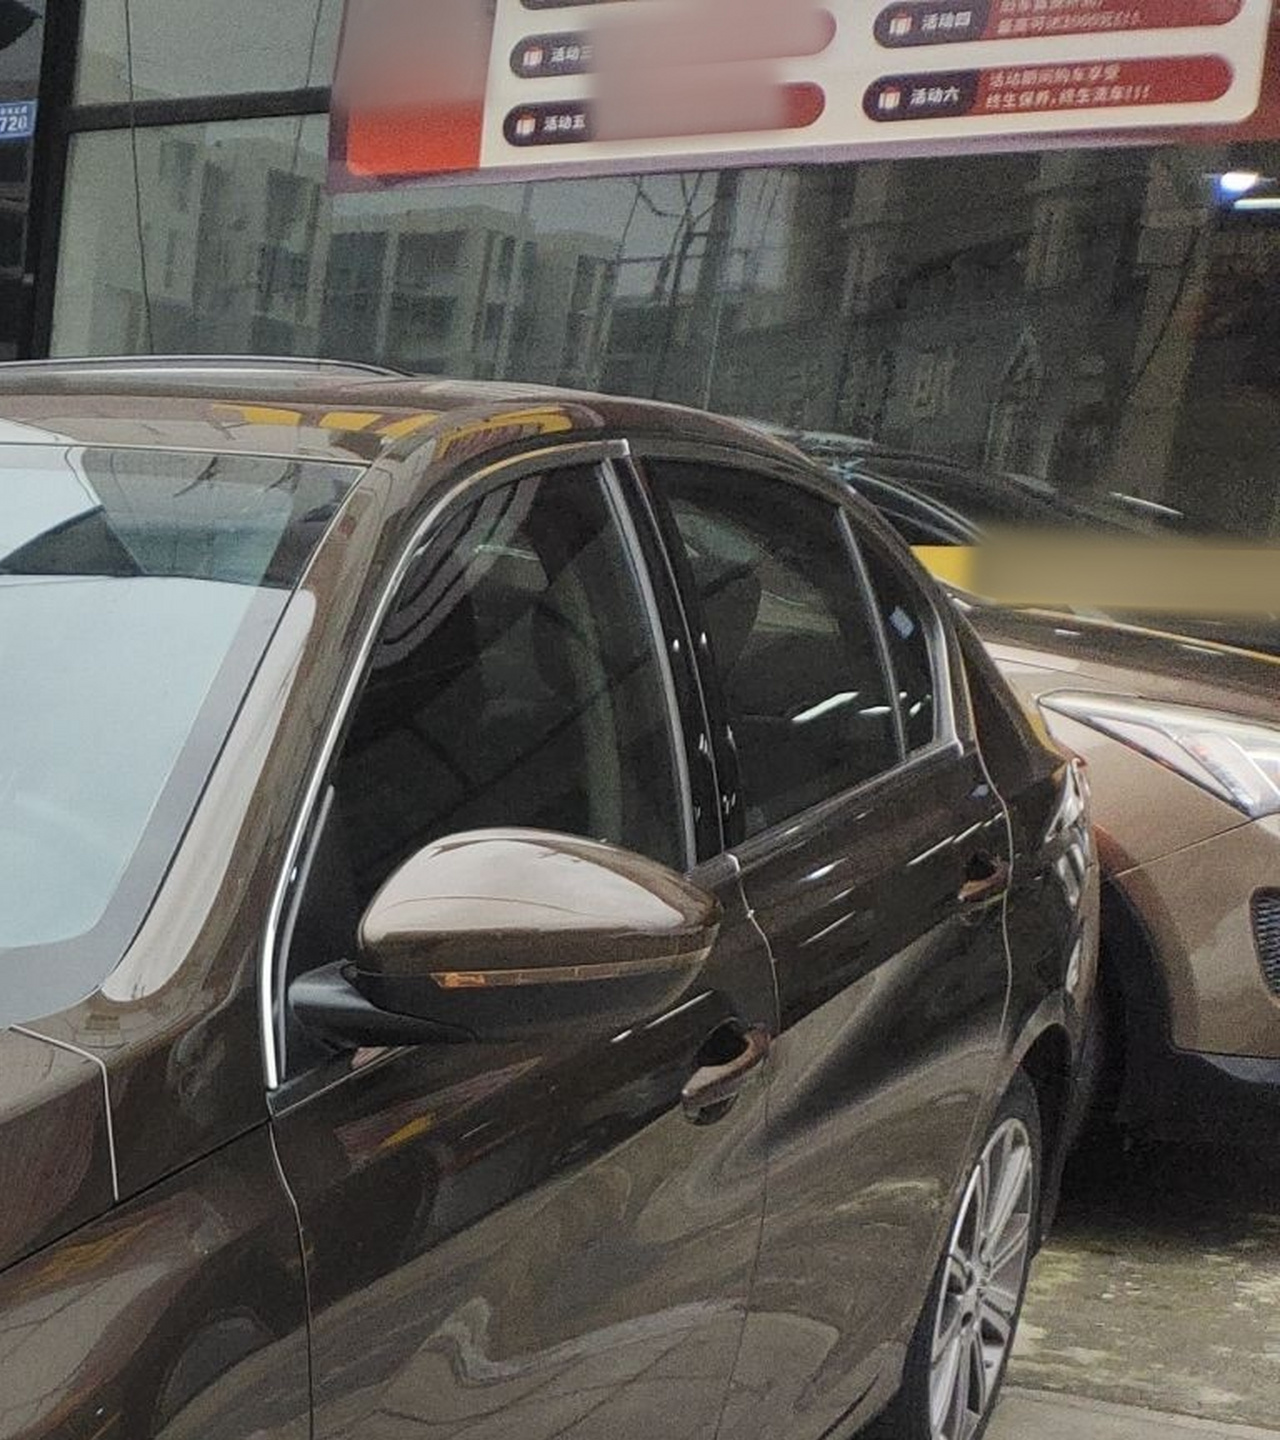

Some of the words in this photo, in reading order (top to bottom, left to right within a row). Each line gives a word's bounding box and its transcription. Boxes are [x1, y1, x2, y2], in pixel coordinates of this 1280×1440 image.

[922, 11, 971, 30] 活动四
[910, 86, 960, 105] 活动六
[543, 113, 586, 131] 活动五
